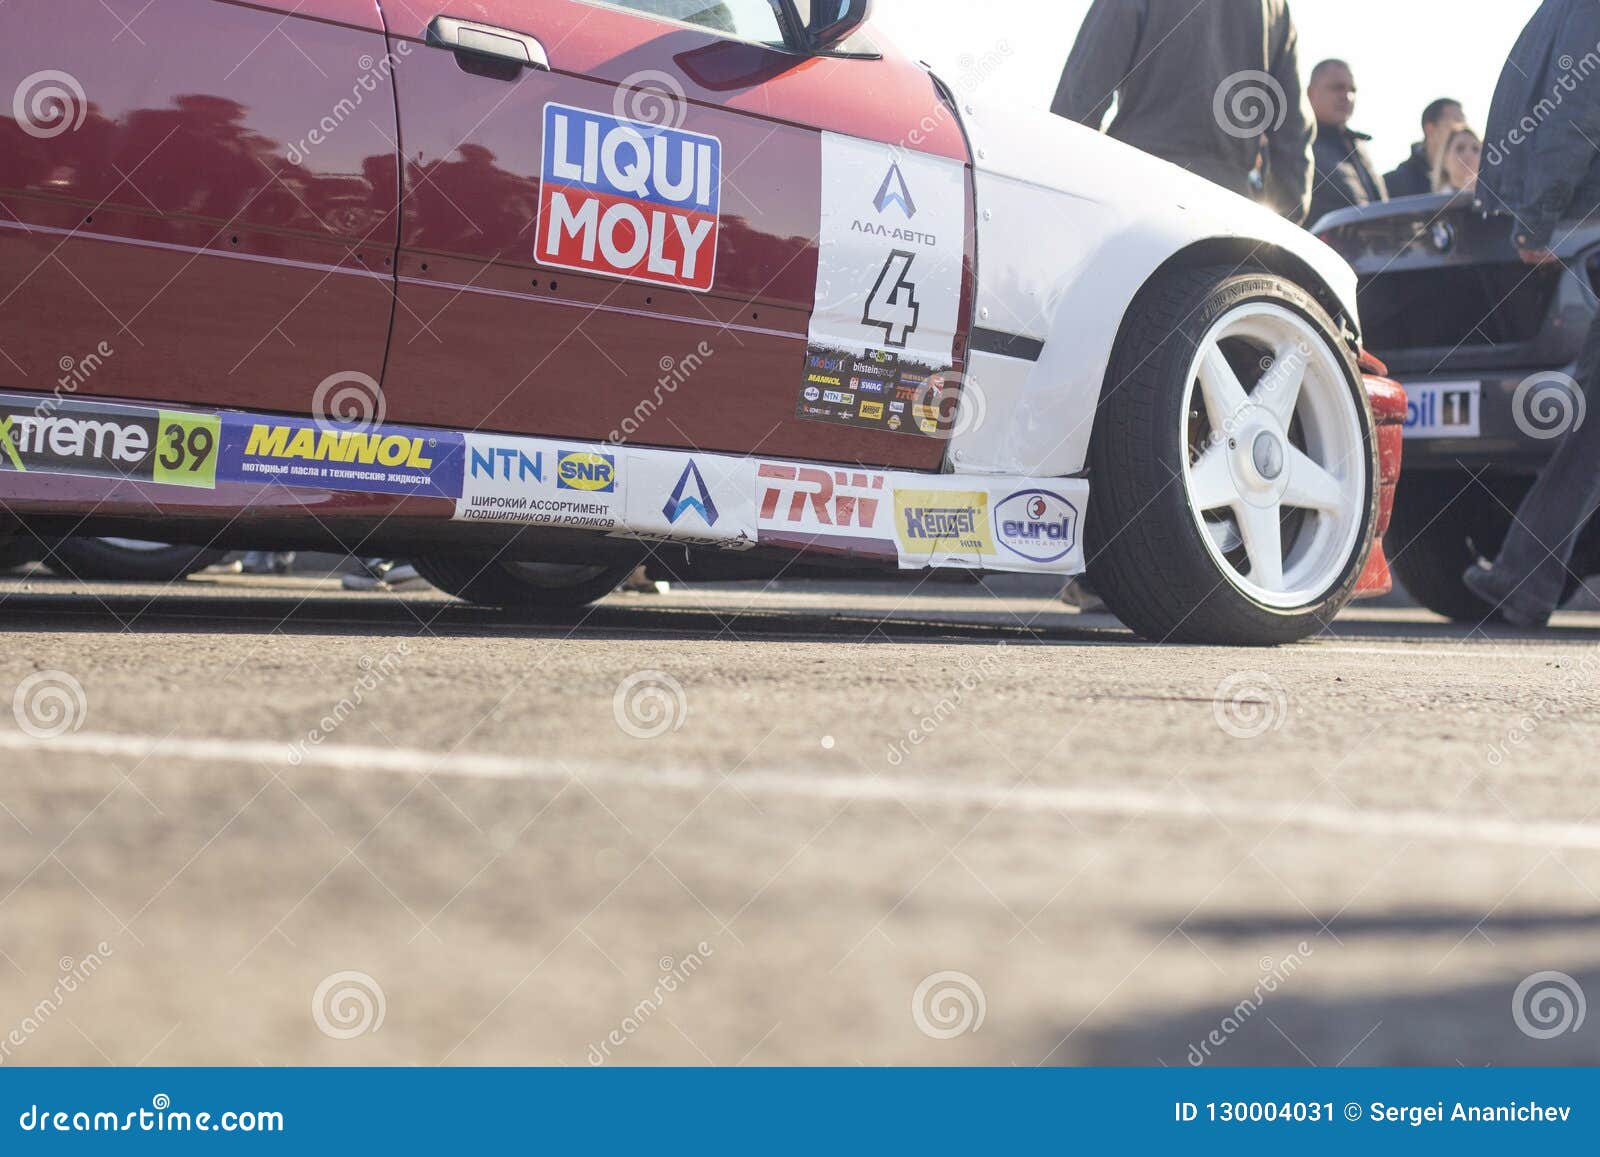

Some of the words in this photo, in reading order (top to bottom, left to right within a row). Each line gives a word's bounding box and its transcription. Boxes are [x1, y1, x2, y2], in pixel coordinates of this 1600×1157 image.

[553, 114, 711, 206] LIQUI
[546, 191, 714, 279] MOLY
[861, 249, 919, 349] 4
[807, 373, 841, 386] MANNOL
[860, 381, 882, 391] SWAG
[160, 424, 213, 472] 39
[244, 424, 433, 470] MANNOL
[242, 462, 288, 475] моторные
[290, 465, 319, 477] масла
[329, 469, 386, 482] технические
[388, 473, 431, 486] жидкости
[471, 446, 542, 483] NTN
[560, 460, 611, 482] SNR
[471, 496, 527, 509] ШИРОКИЙ
[530, 500, 609, 515] АССОРТИМЕНТ
[758, 463, 884, 528] TRW
[464, 509, 551, 523] ПОДШИПНИКОВ
[553, 514, 562, 523] И
[563, 515, 615, 528] РОЛИКОВ
[904, 506, 976, 539] Hengst
[1003, 517, 1070, 541] eurol
[960, 539, 983, 548] FILTER
